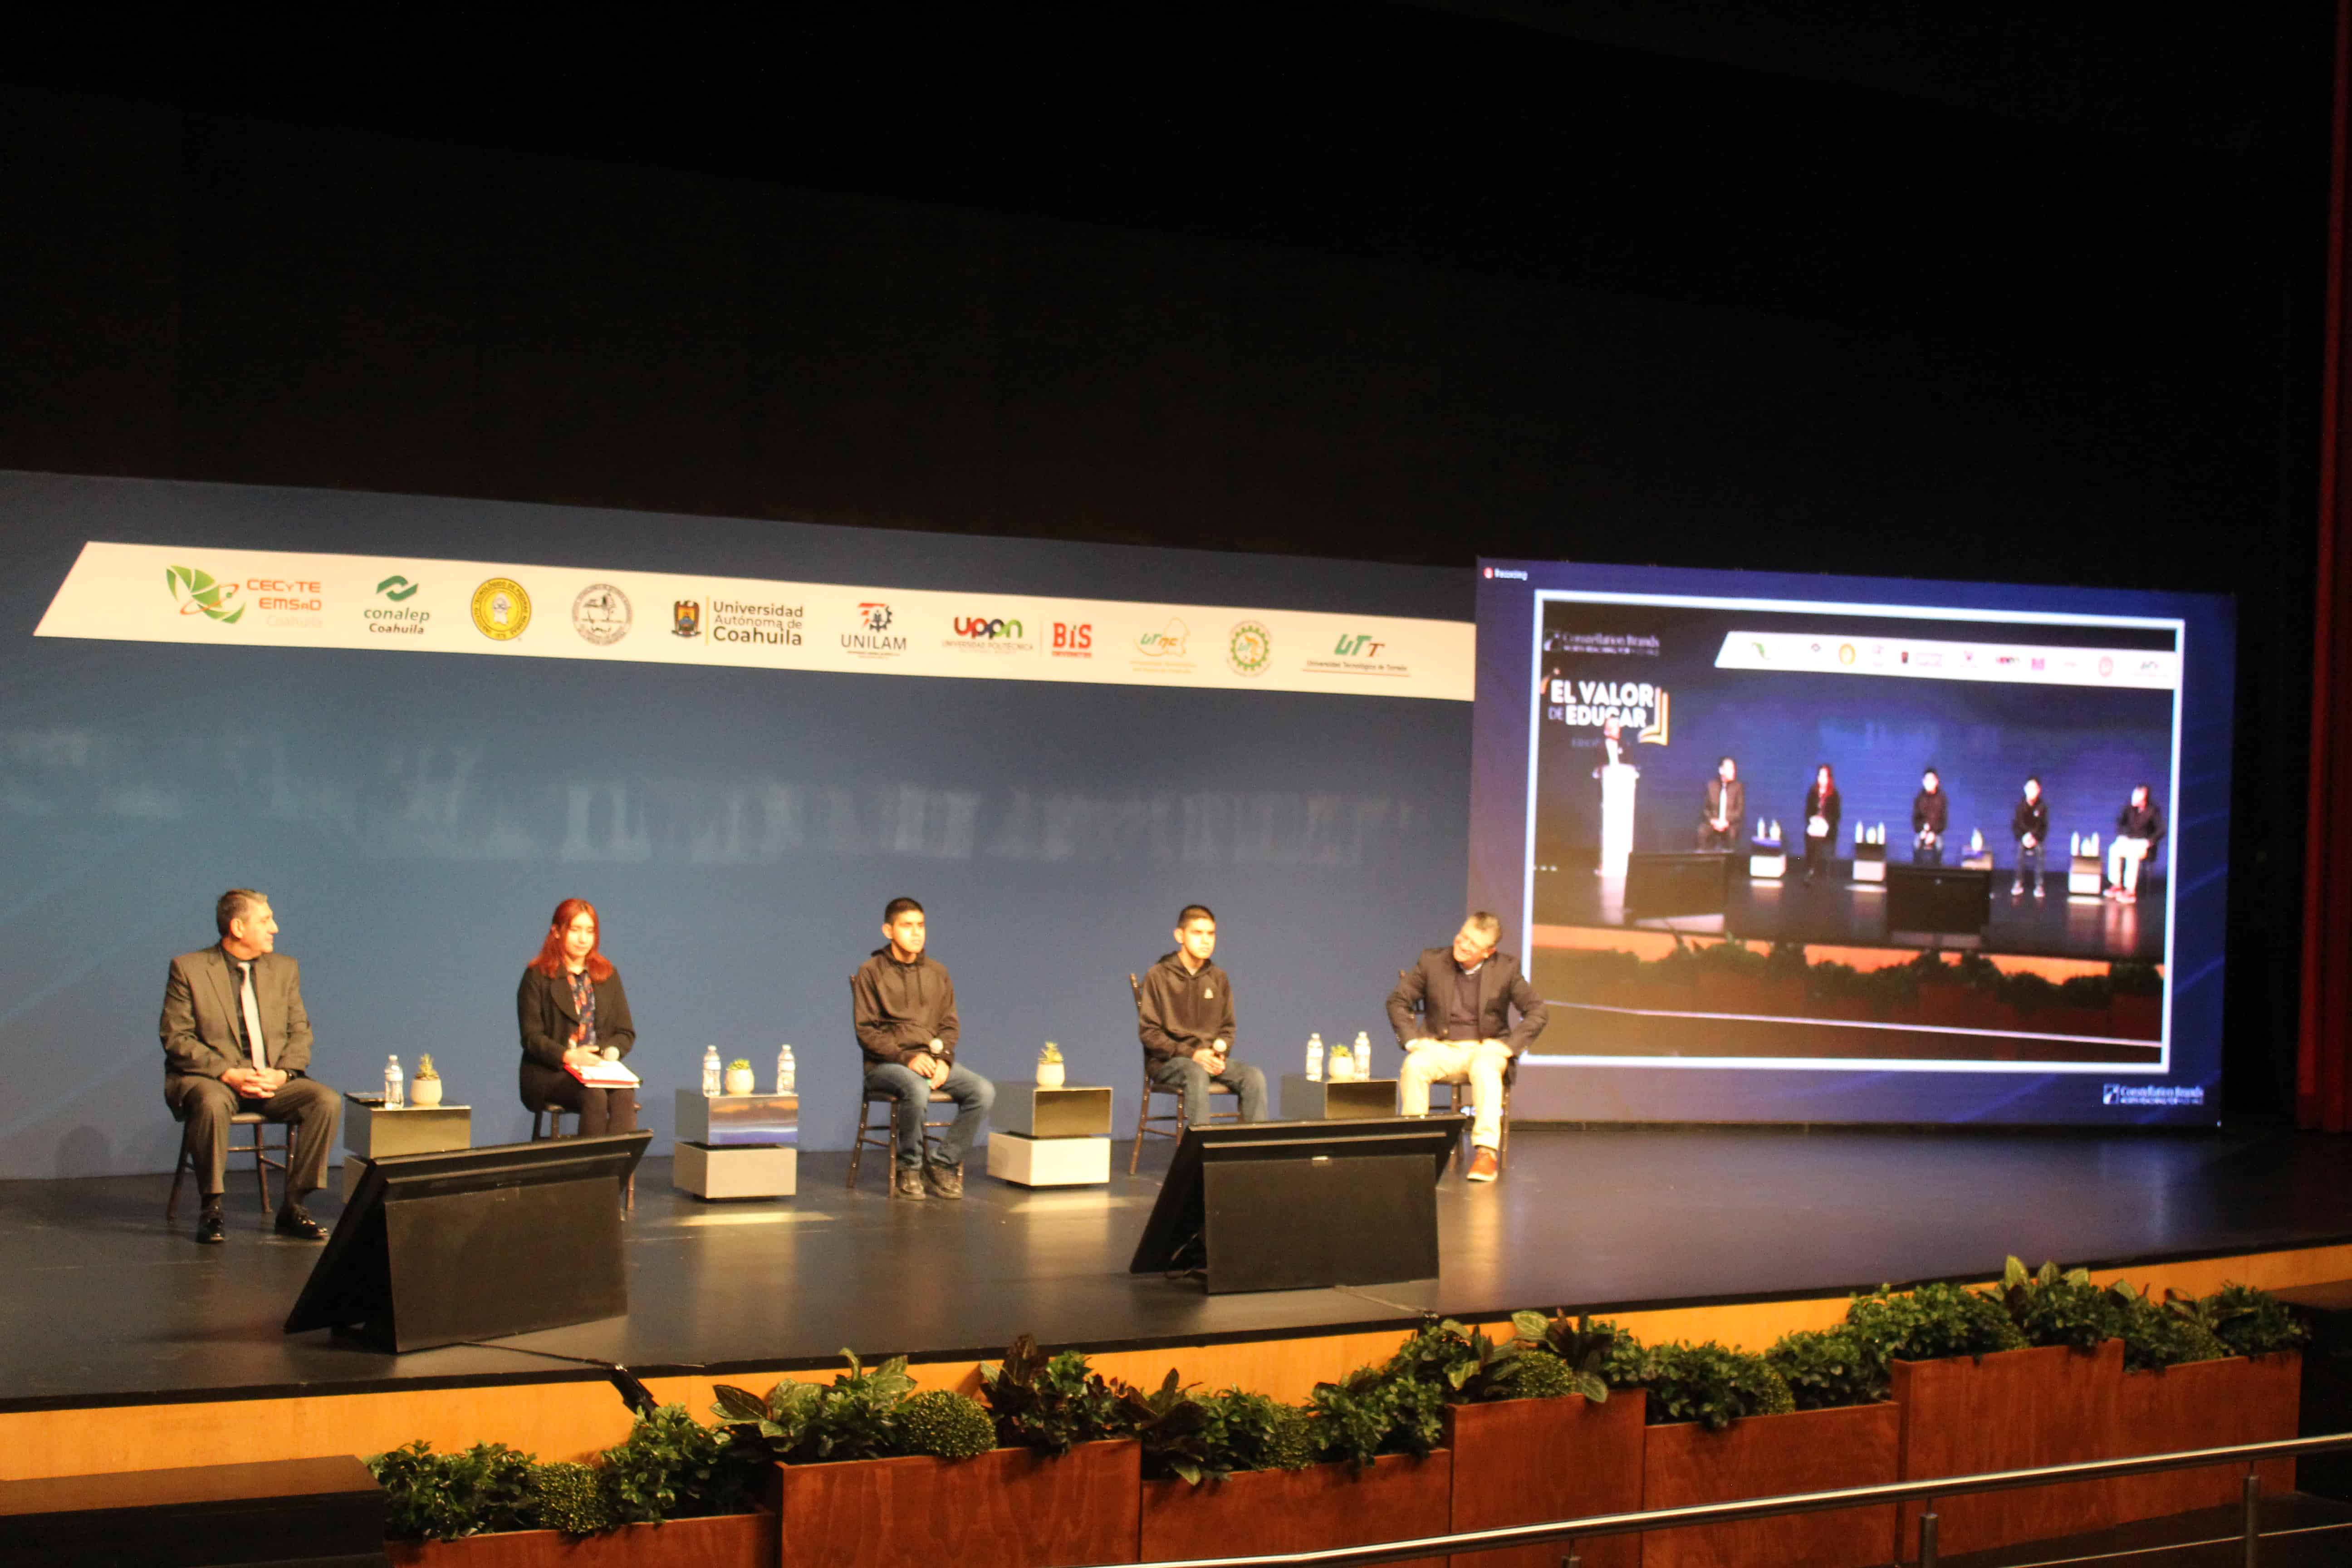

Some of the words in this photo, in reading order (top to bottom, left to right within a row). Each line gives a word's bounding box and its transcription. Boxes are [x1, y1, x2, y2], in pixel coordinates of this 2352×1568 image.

[364, 608, 430, 622] conalep
[713, 601, 803, 617] Universidad
[369, 623, 424, 635] Coahuila
[714, 614, 783, 628] Autónoma
[787, 619, 802, 629] de
[713, 626, 802, 646] Coahuila
[841, 634, 906, 650] UNILAM
[1551, 680, 1576, 703] EL
[1578, 681, 1654, 707] VALOR
[1548, 706, 1563, 720] DE
